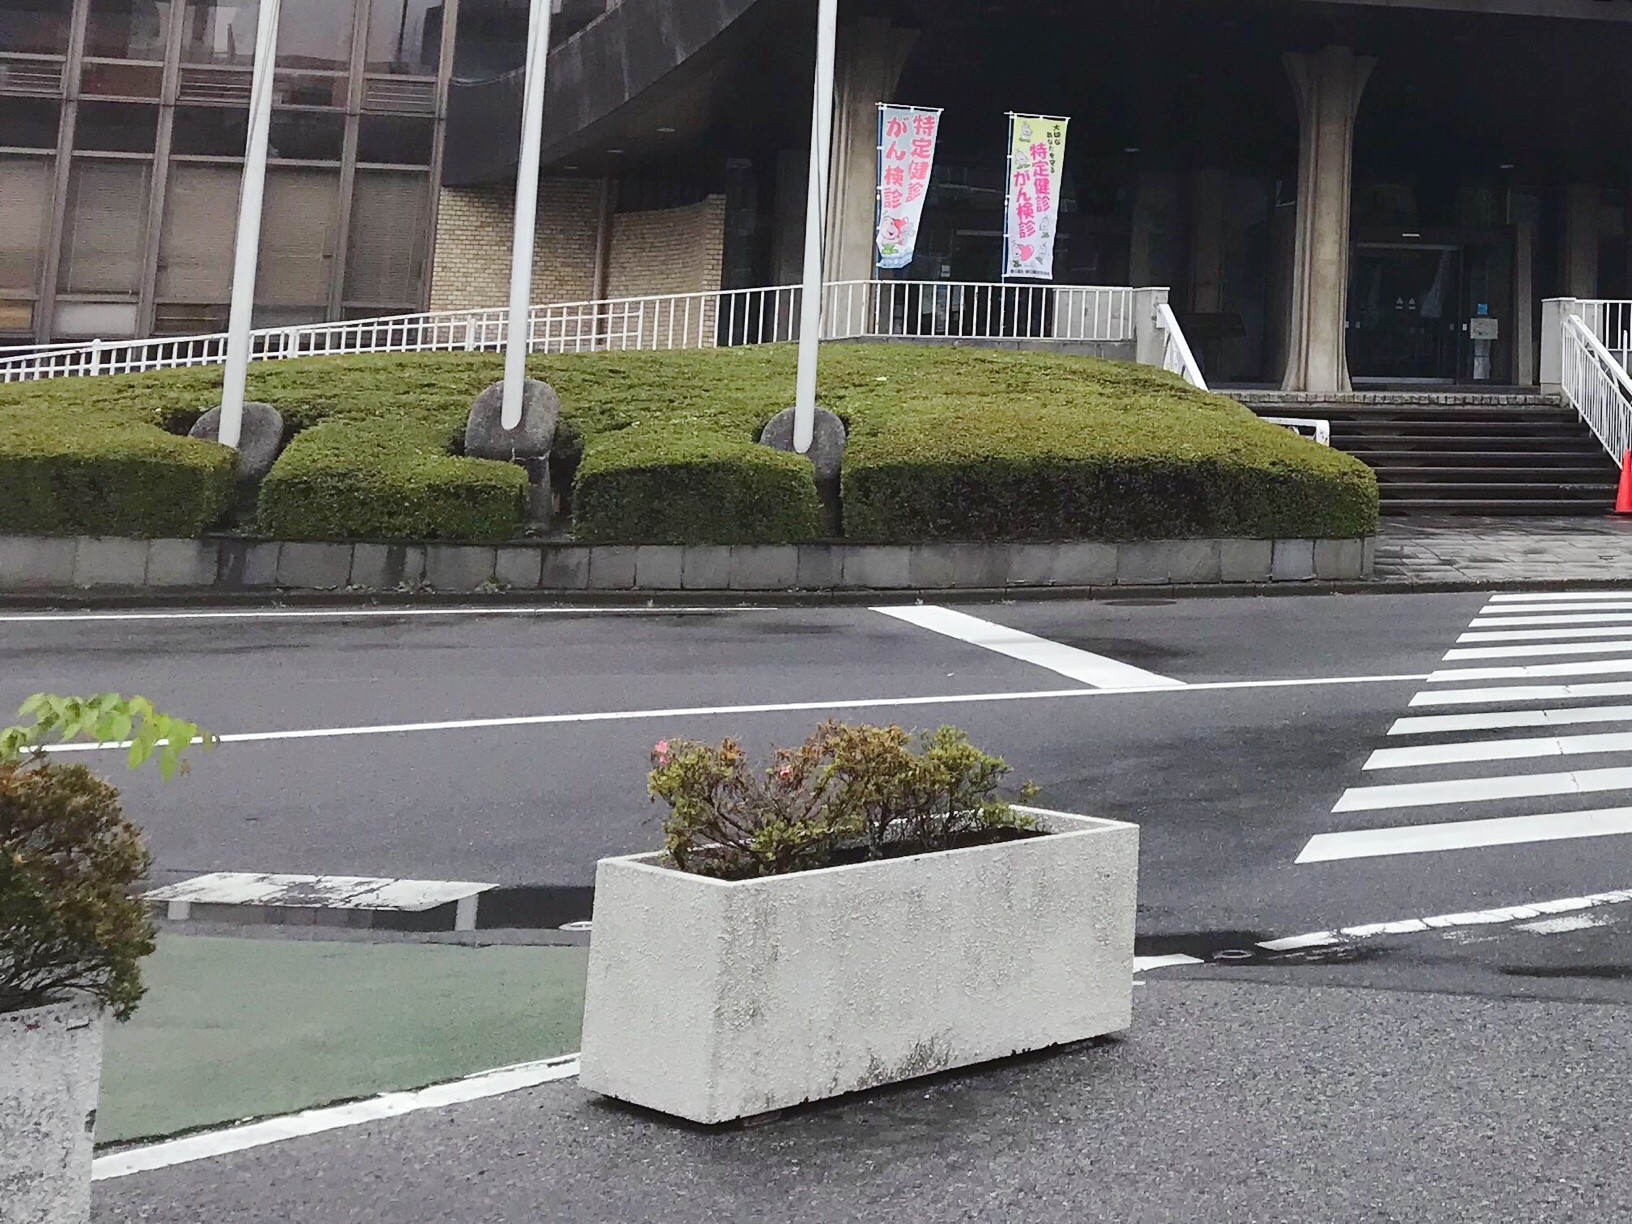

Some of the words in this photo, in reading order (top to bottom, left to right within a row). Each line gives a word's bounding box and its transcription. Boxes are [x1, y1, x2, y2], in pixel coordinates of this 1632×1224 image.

[883, 116, 909, 209] がん検診
[905, 113, 935, 203] 特定健診
[1029, 142, 1051, 213] 特定健診
[1014, 169, 1036, 239] がん検診
